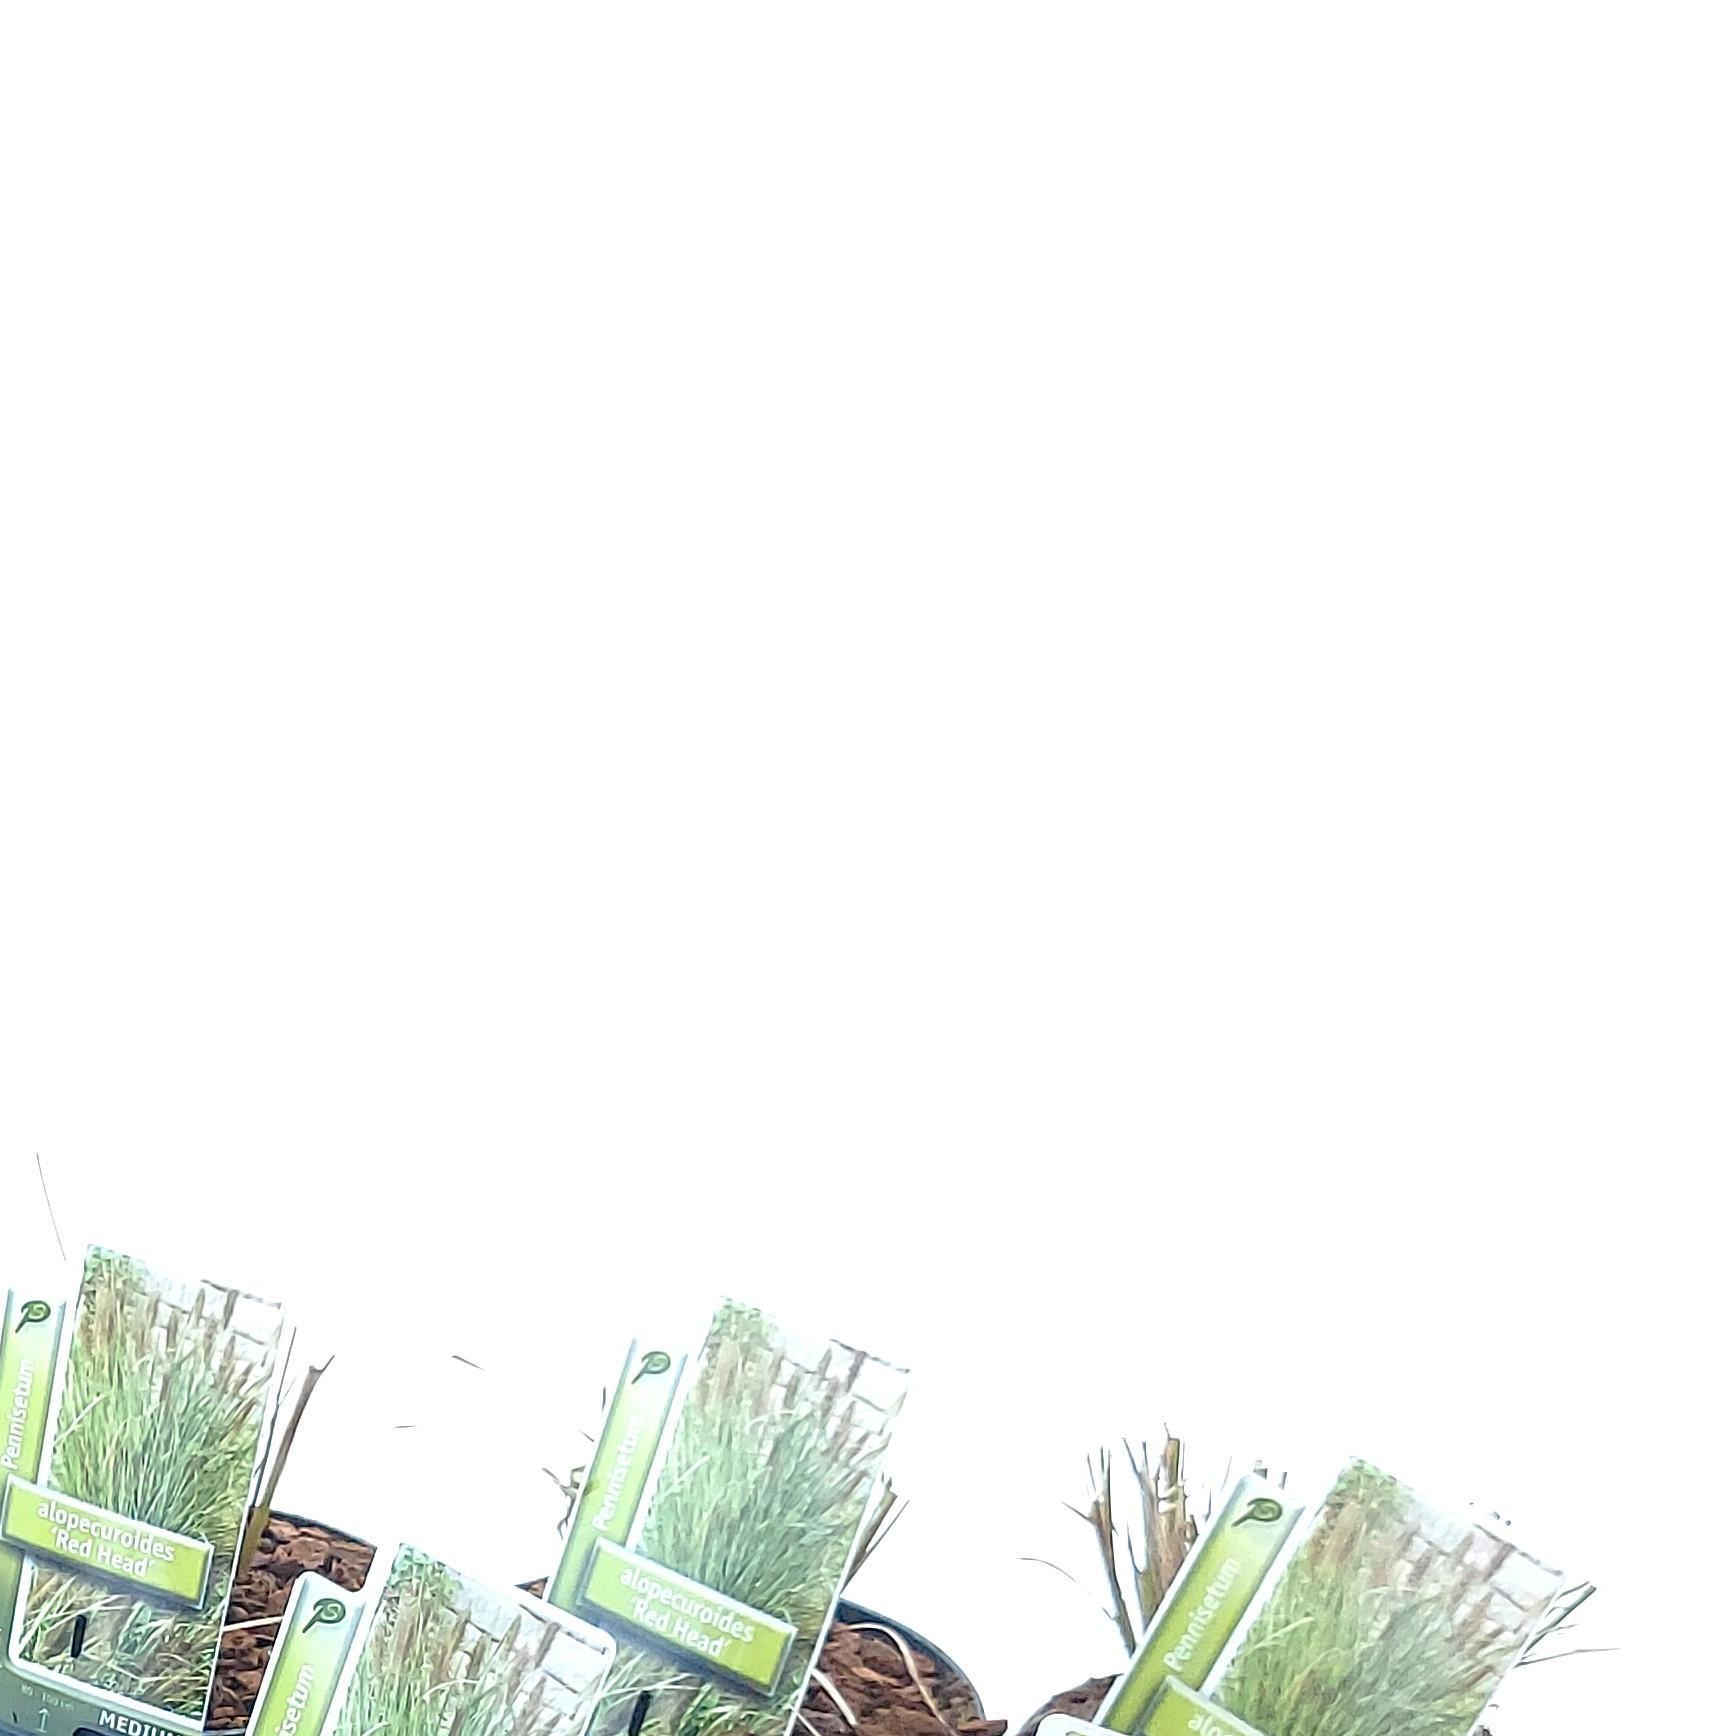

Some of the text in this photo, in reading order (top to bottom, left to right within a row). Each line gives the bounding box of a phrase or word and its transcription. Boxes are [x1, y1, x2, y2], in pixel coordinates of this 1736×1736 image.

[0, 1359, 35, 1470] Pennisetum
[37, 1500, 176, 1562] alopecuroides
[619, 1567, 756, 1643] alopecuroides
[1164, 1557, 1241, 1672] Pennisetum
